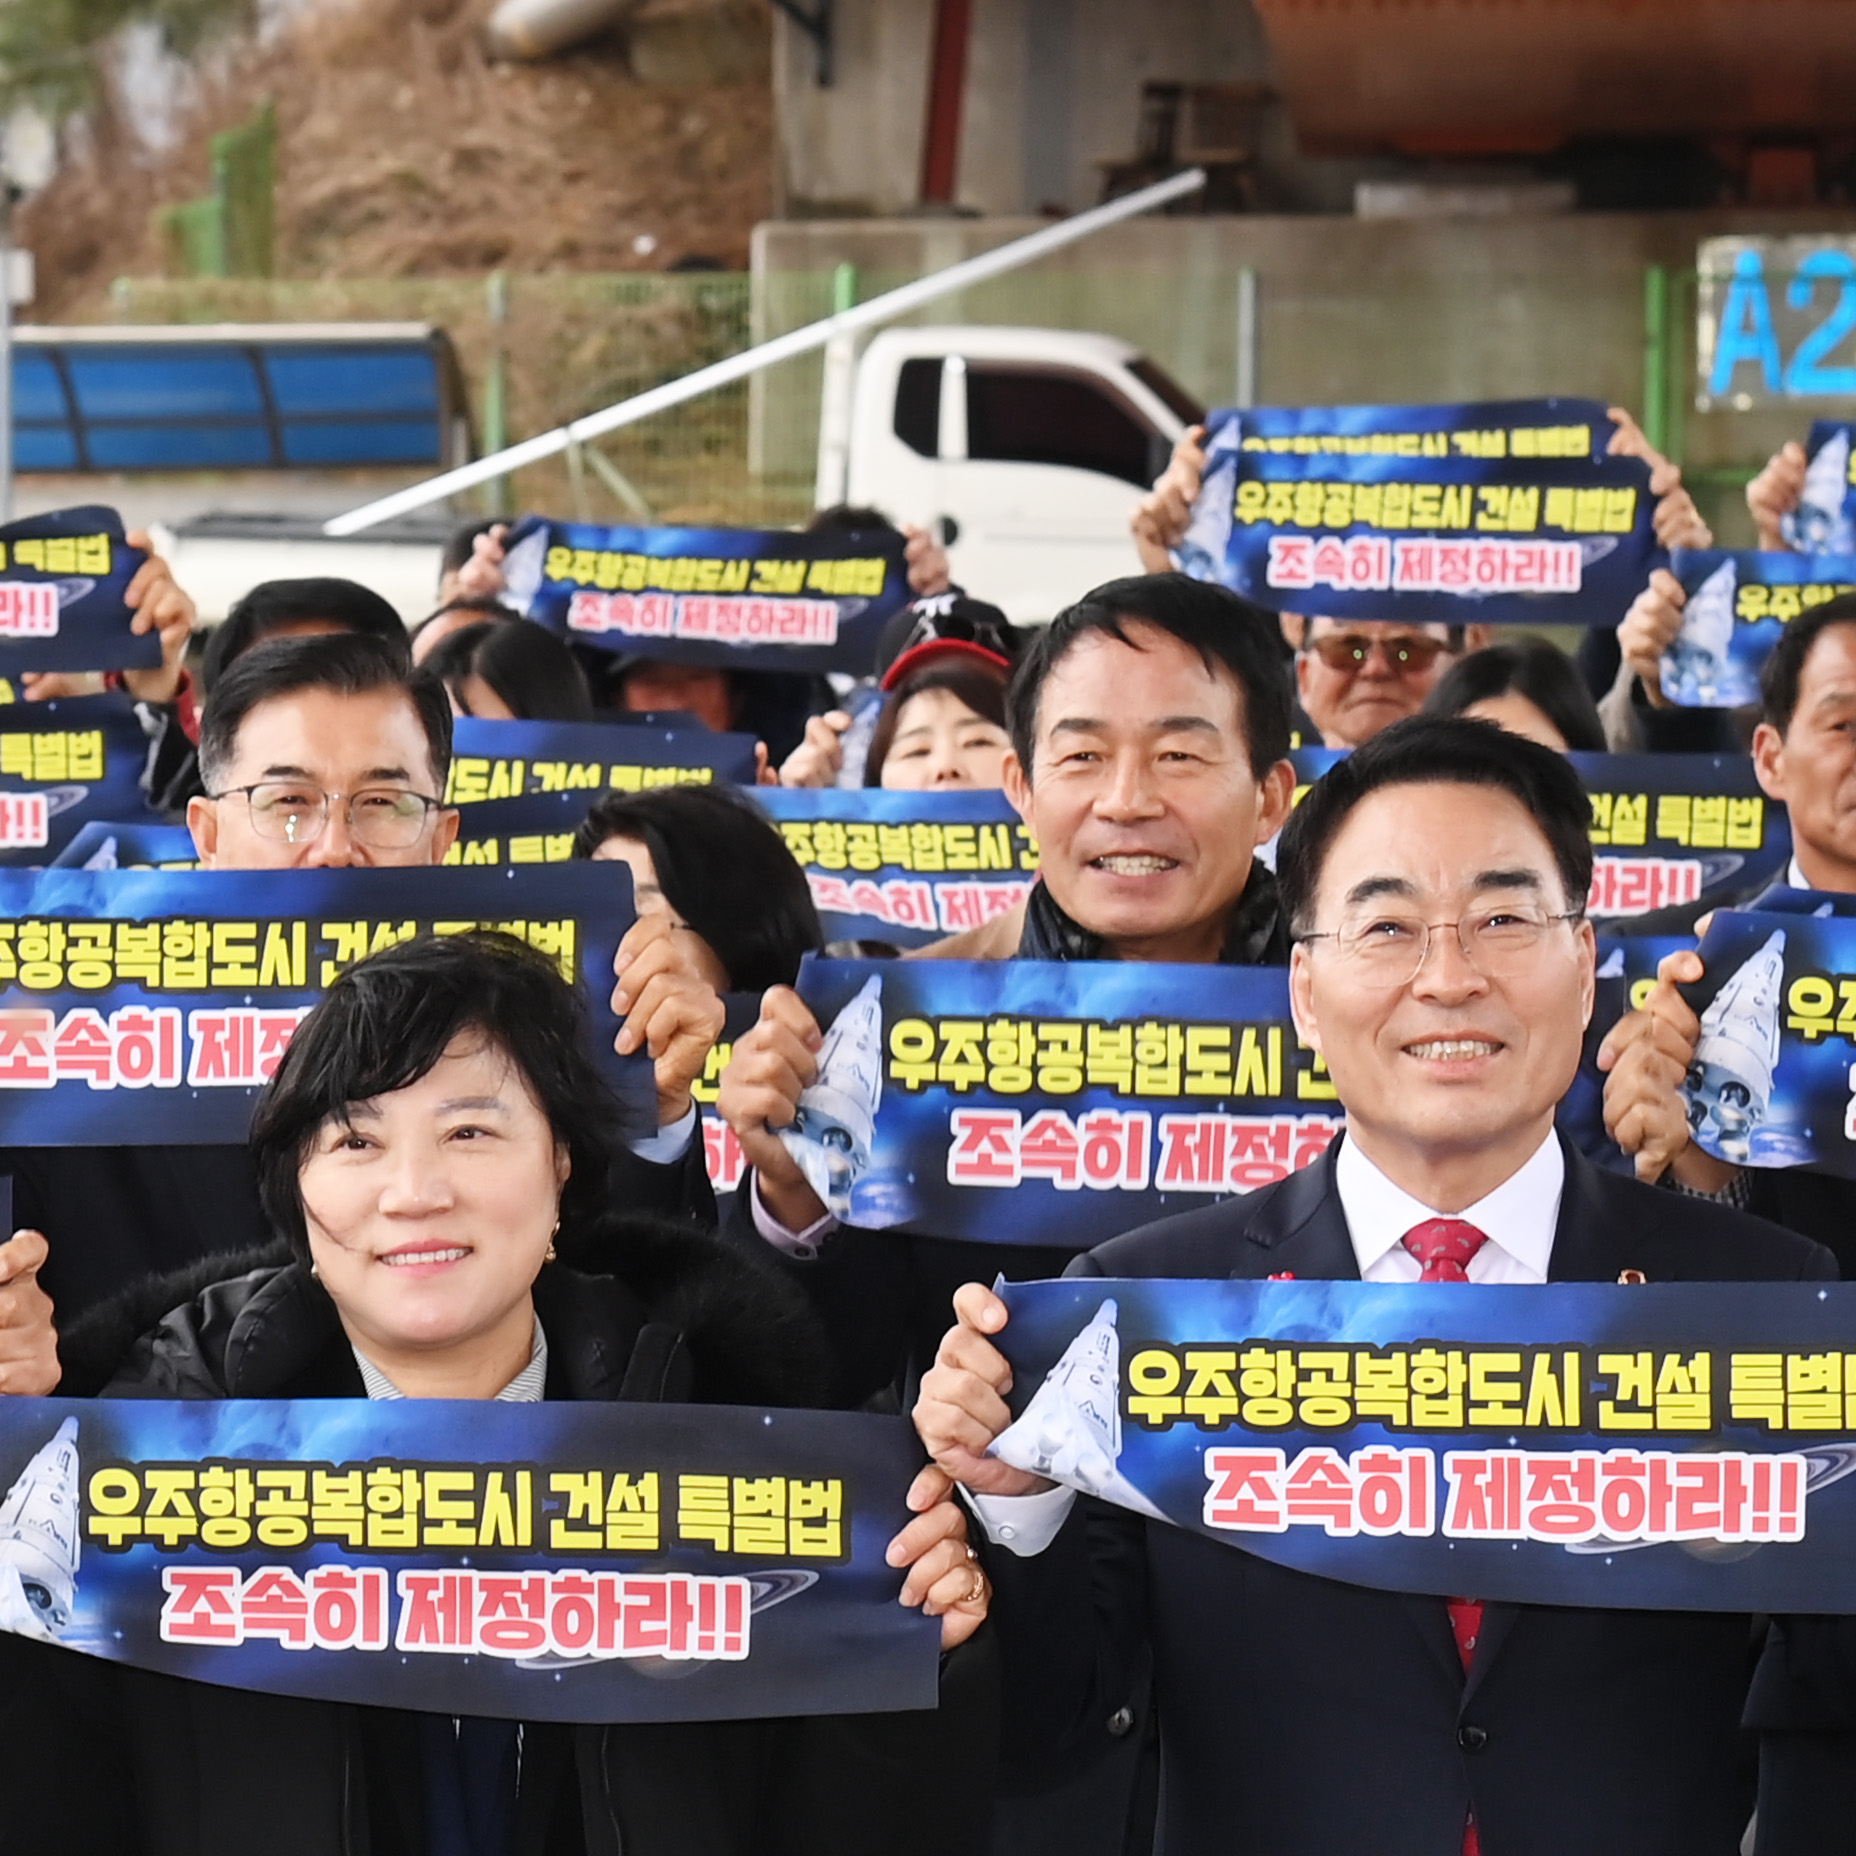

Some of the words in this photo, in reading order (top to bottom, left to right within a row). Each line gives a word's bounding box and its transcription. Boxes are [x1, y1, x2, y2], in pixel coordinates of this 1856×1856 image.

[1236, 480, 1473, 530] 우주항공복합도시
[1477, 486, 1540, 532] 건설
[1545, 487, 1637, 533] 특별법
[546, 546, 750, 592] 우주항공복합도시
[1272, 540, 1388, 585] 조속히
[573, 592, 673, 632] 조속히
[775, 821, 1013, 872] 주항공복합도시
[1657, 795, 1763, 849] 특별법
[1584, 861, 1698, 913] 하라!!
[891, 1018, 1282, 1097] 우주항공복합도시
[953, 1114, 1147, 1184] 조속히
[1129, 1347, 1581, 1428] 우주항공복합도시
[1599, 1351, 1712, 1430] 건설
[90, 1466, 532, 1548] 우주항공복합도시
[551, 1470, 660, 1551] 건설
[679, 1474, 843, 1557] 특별법
[1210, 1450, 1429, 1531] 조속히
[1449, 1453, 1801, 1537] 제정하라!!
[166, 1568, 383, 1645] 조속히
[402, 1573, 745, 1655] 제정하라!!
